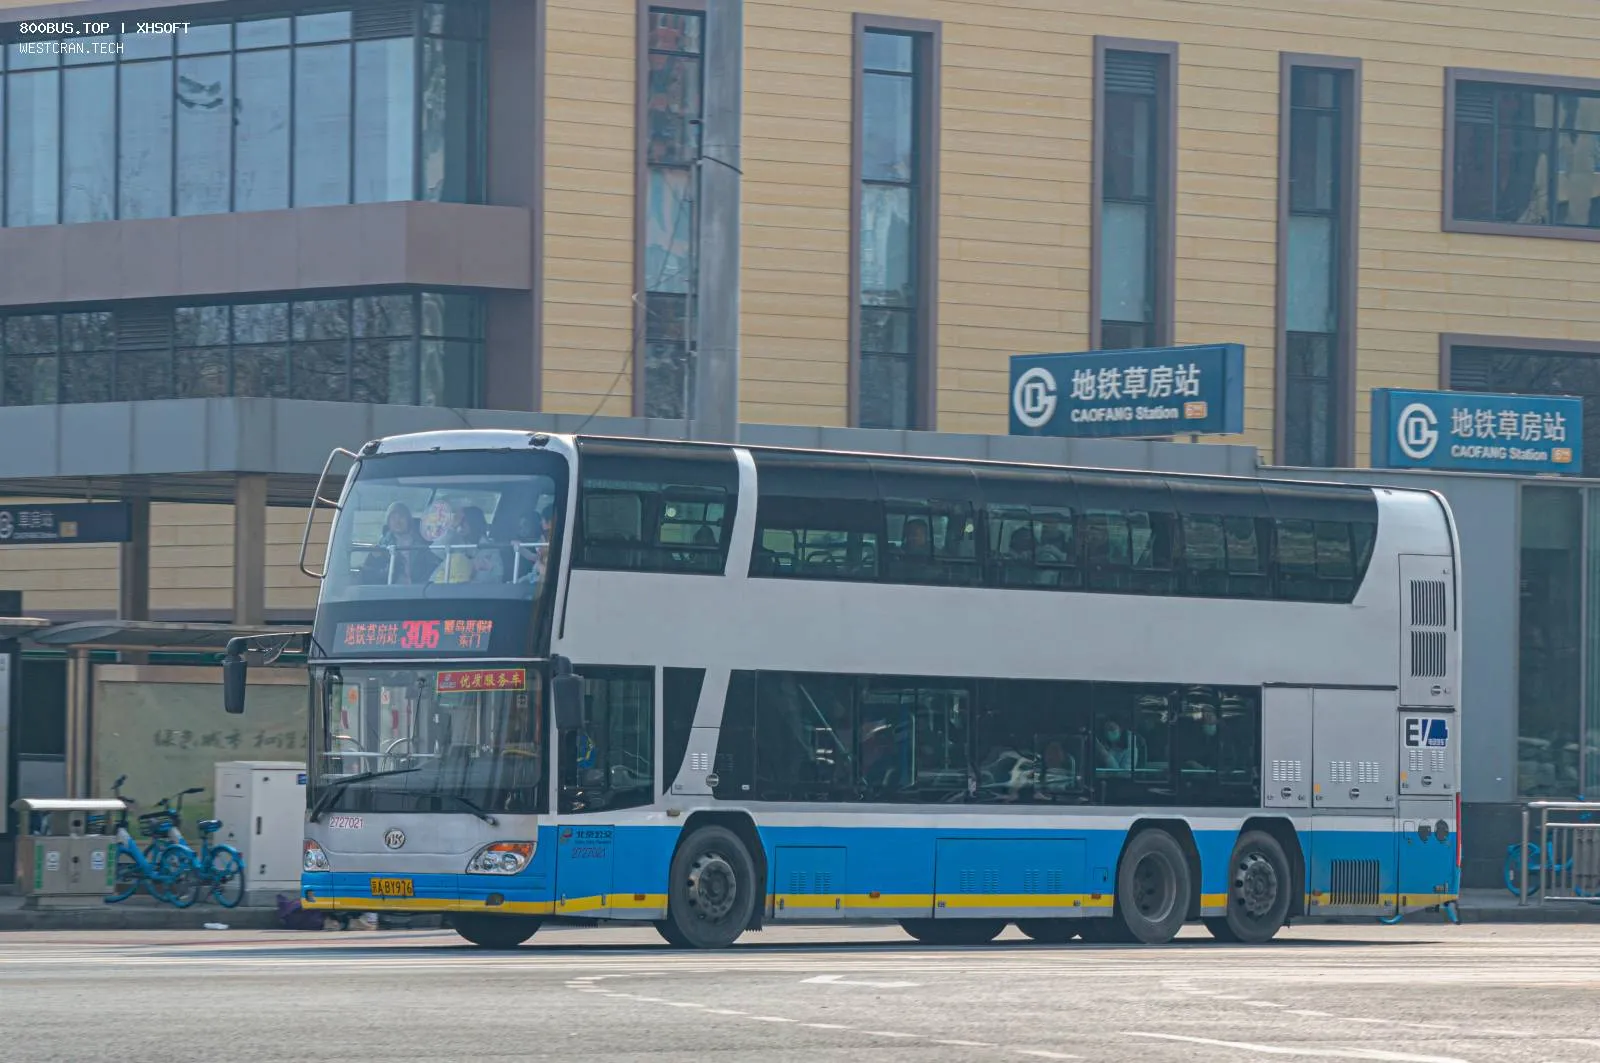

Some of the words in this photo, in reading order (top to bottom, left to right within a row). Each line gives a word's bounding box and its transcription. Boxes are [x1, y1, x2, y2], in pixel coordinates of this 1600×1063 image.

[1070, 363, 1201, 400] 地铁草房站
[1071, 407, 1133, 423] CAOFANG
[1135, 405, 1179, 421] Station
[1451, 408, 1567, 442] 地铁草房站
[1451, 445, 1507, 460] CAOFANG
[1509, 447, 1548, 461] Station
[401, 620, 441, 649] 305
[329, 815, 364, 829] 2727021
